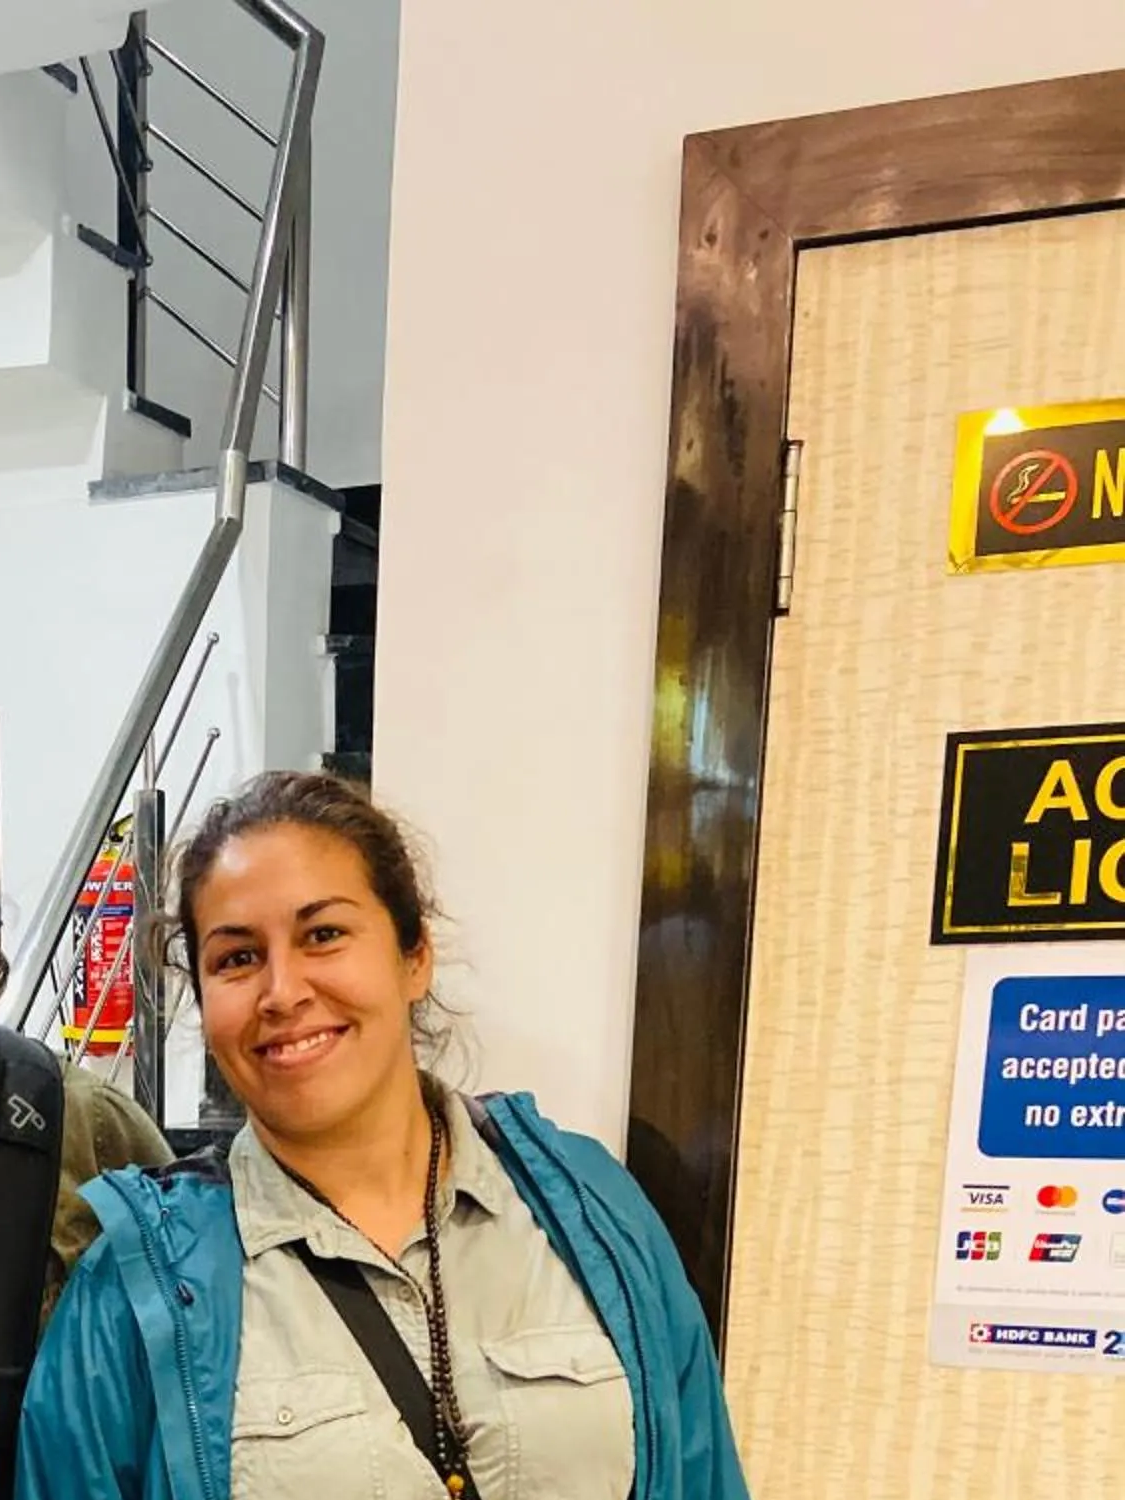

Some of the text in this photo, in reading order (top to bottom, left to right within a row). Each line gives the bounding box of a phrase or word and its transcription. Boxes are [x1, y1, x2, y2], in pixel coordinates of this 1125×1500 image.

[1019, 1003, 1088, 1032] Card
[1025, 1104, 1061, 1128] no
[968, 1192, 1005, 1205] VISA
[995, 1328, 1090, 1344] HDFC BANK
